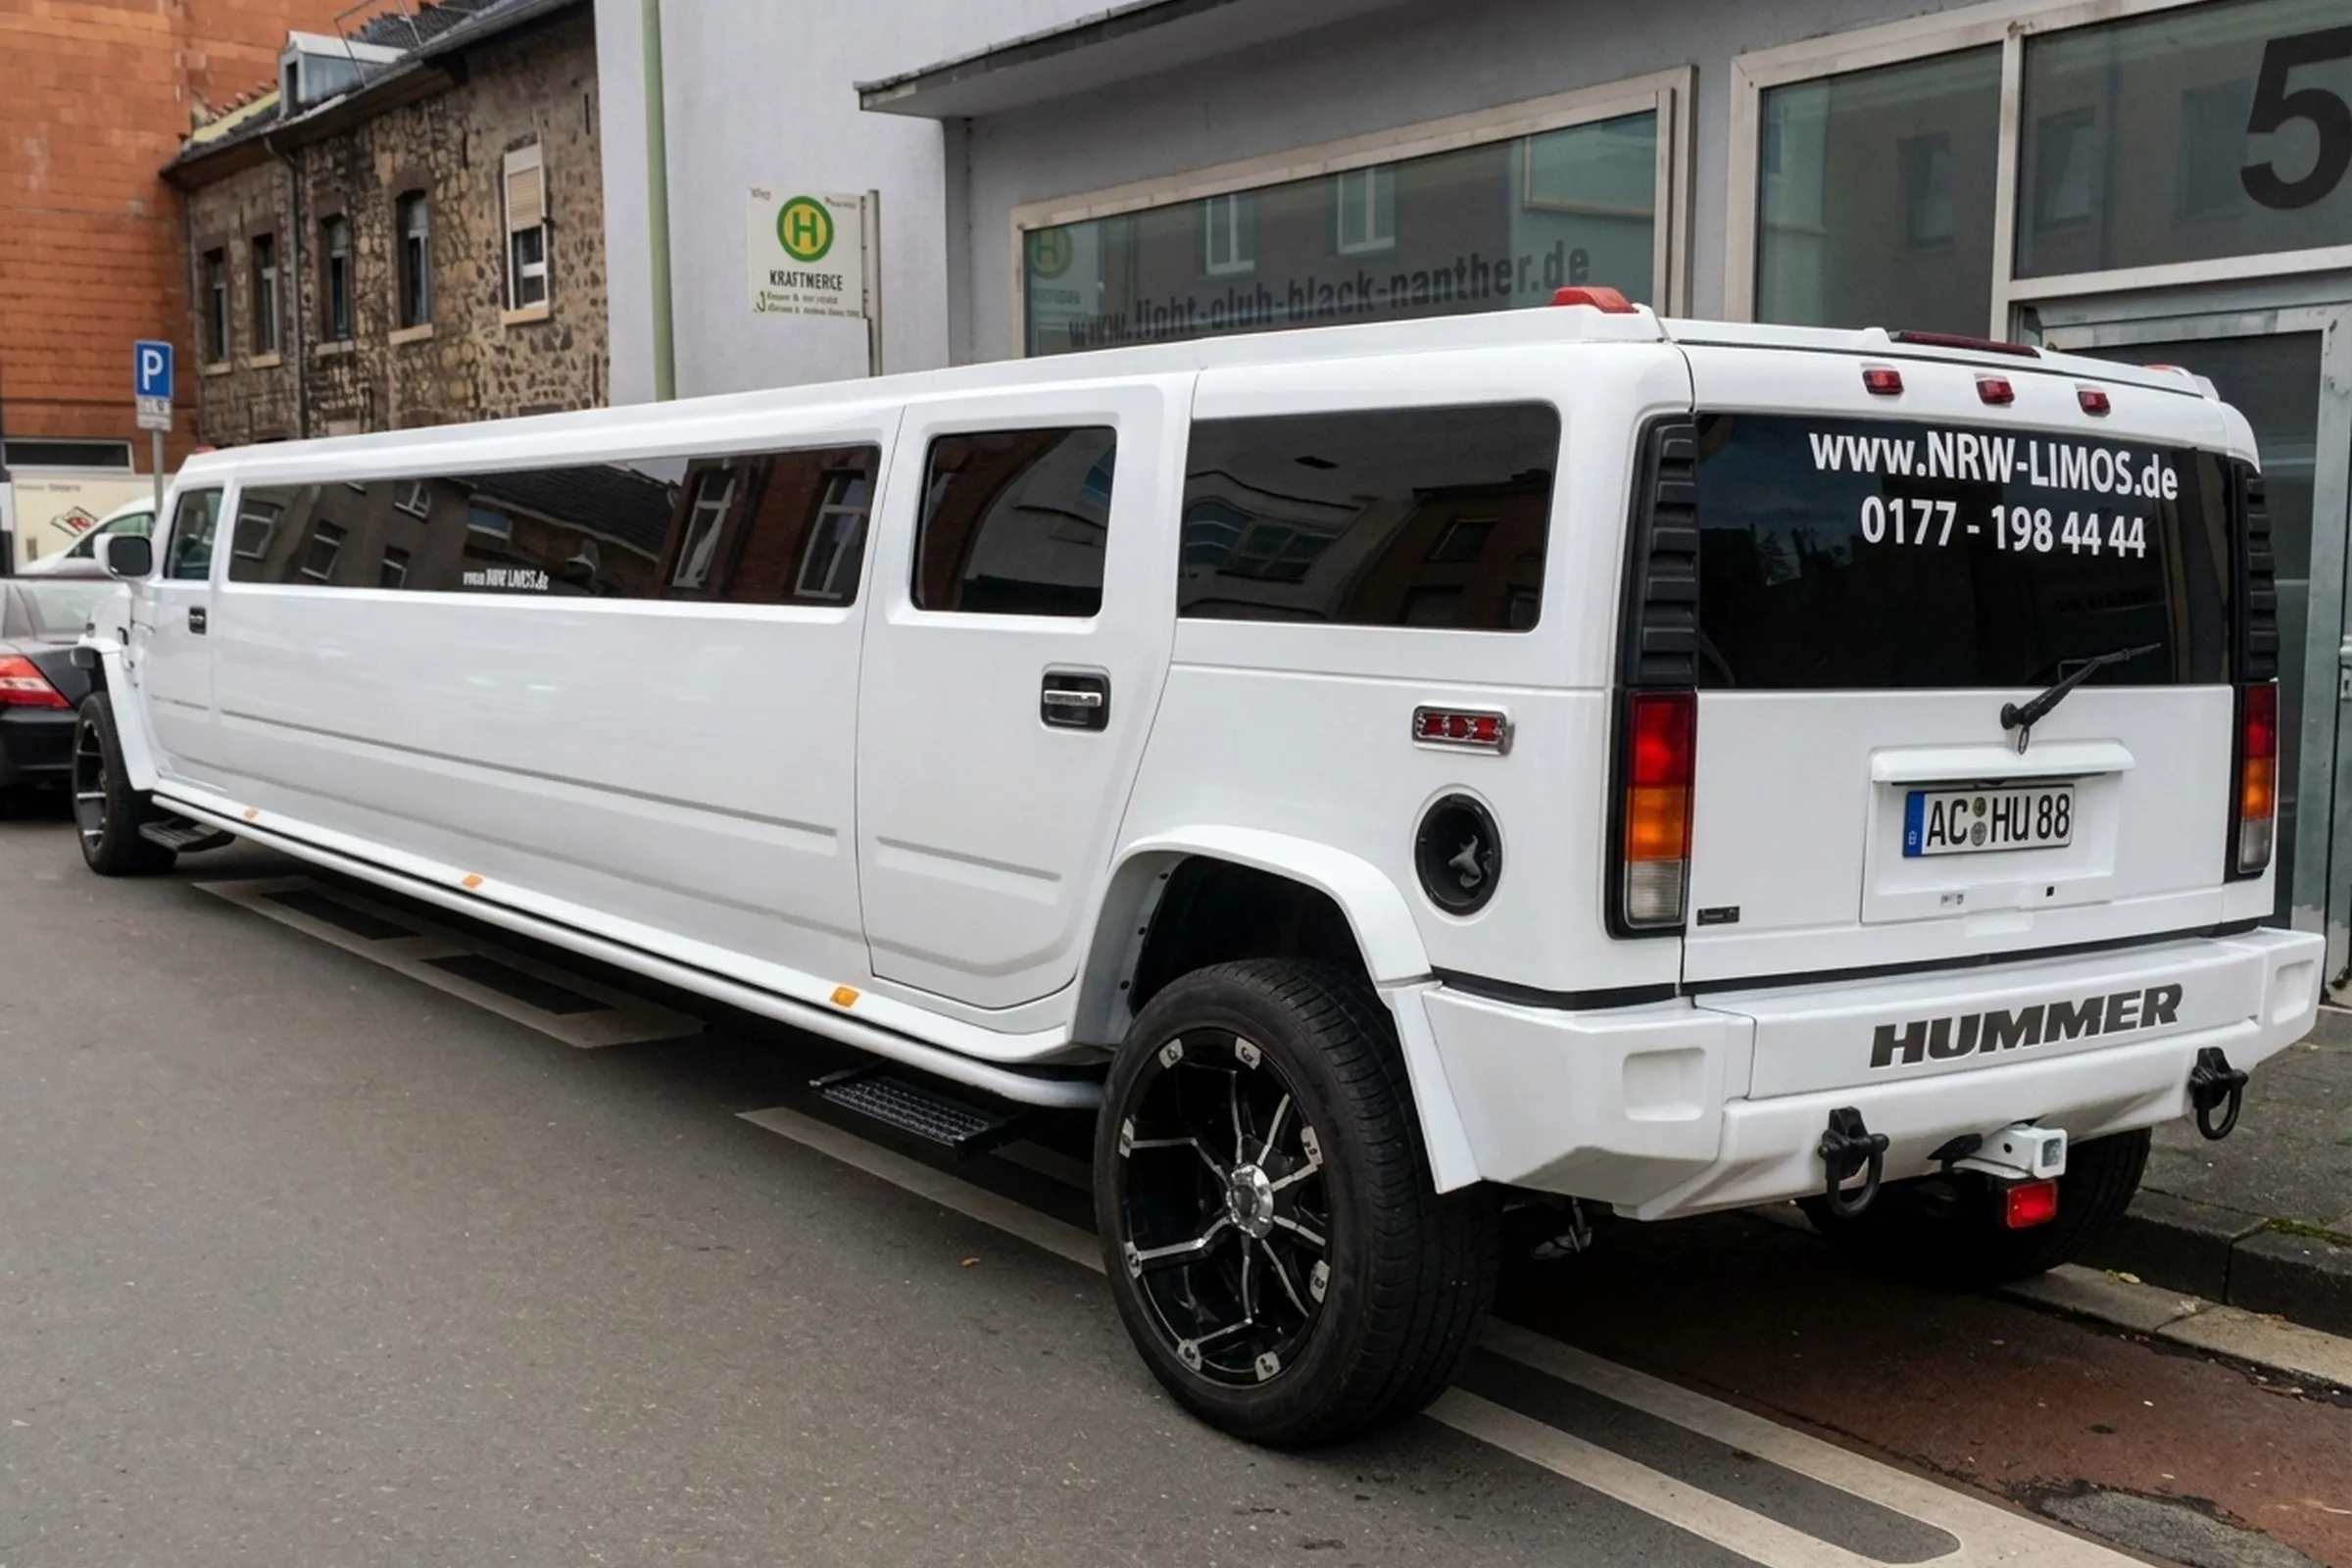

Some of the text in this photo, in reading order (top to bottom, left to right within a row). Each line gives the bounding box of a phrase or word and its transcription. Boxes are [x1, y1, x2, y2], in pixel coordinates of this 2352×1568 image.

[2240, 25, 2352, 210] 5
[792, 211, 818, 247] H
[142, 349, 164, 390] P
[1809, 430, 2179, 501] www.NRW-LIMOS.de
[1862, 495, 1956, 547] 0177
[1991, 504, 2053, 553] 198
[2061, 512, 2102, 556] 44
[2108, 514, 2146, 559] 44
[1927, 793, 2071, 848] AC HU 88
[1869, 983, 2183, 1067] HUMMER
